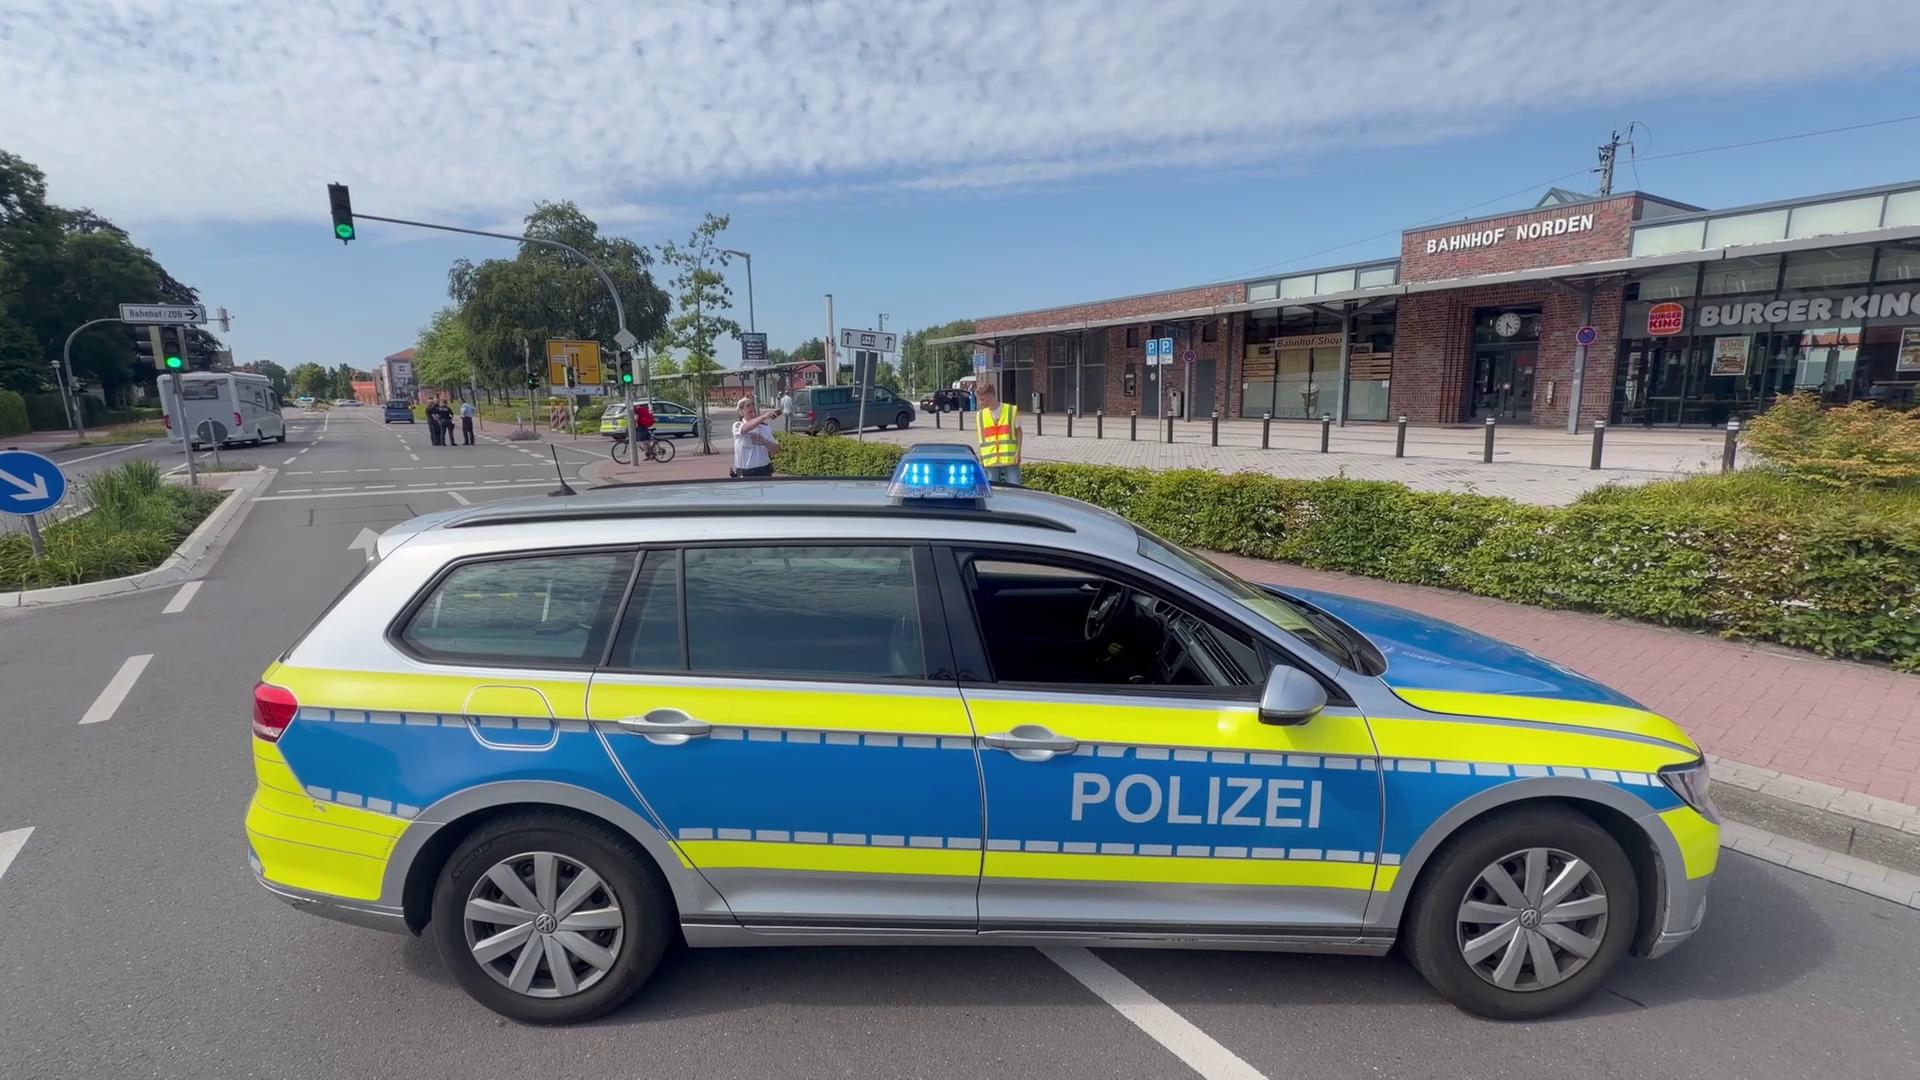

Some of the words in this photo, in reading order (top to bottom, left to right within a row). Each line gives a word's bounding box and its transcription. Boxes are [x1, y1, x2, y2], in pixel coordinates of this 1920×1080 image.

[1426, 228, 1505, 254] BAHNHOF
[1516, 213, 1594, 241] NORDEN
[129, 309, 162, 319] Bahnhof
[1699, 297, 1834, 327] BURGER
[1650, 319, 1681, 328] KING
[1277, 336, 1343, 348] Bahnhof-Shop
[1071, 772, 1323, 829] POLIZEI
